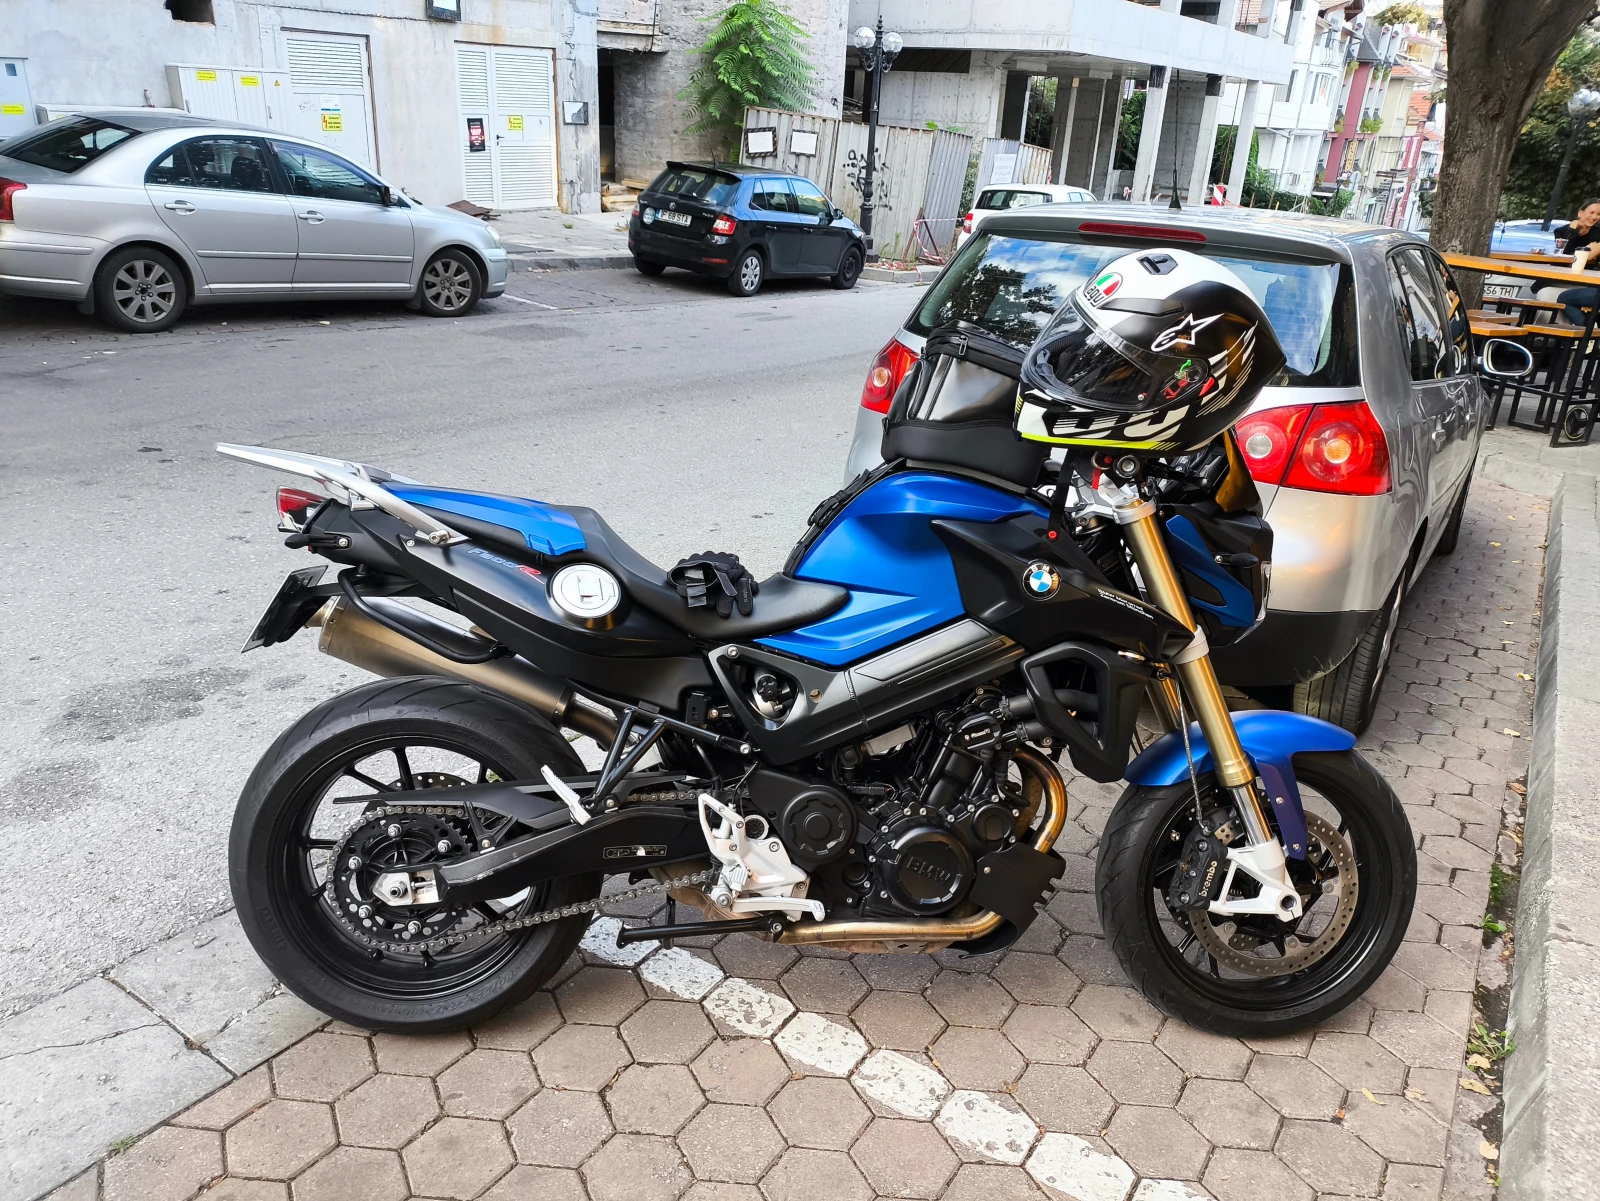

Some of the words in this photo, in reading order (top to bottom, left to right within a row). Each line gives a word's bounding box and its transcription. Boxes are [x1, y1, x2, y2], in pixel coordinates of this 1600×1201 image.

[1500, 287, 1512, 297] TH
[905, 855, 952, 883] BMW
[1198, 860, 1218, 897] brembo
[1272, 1000, 1321, 1020] ROSSO
